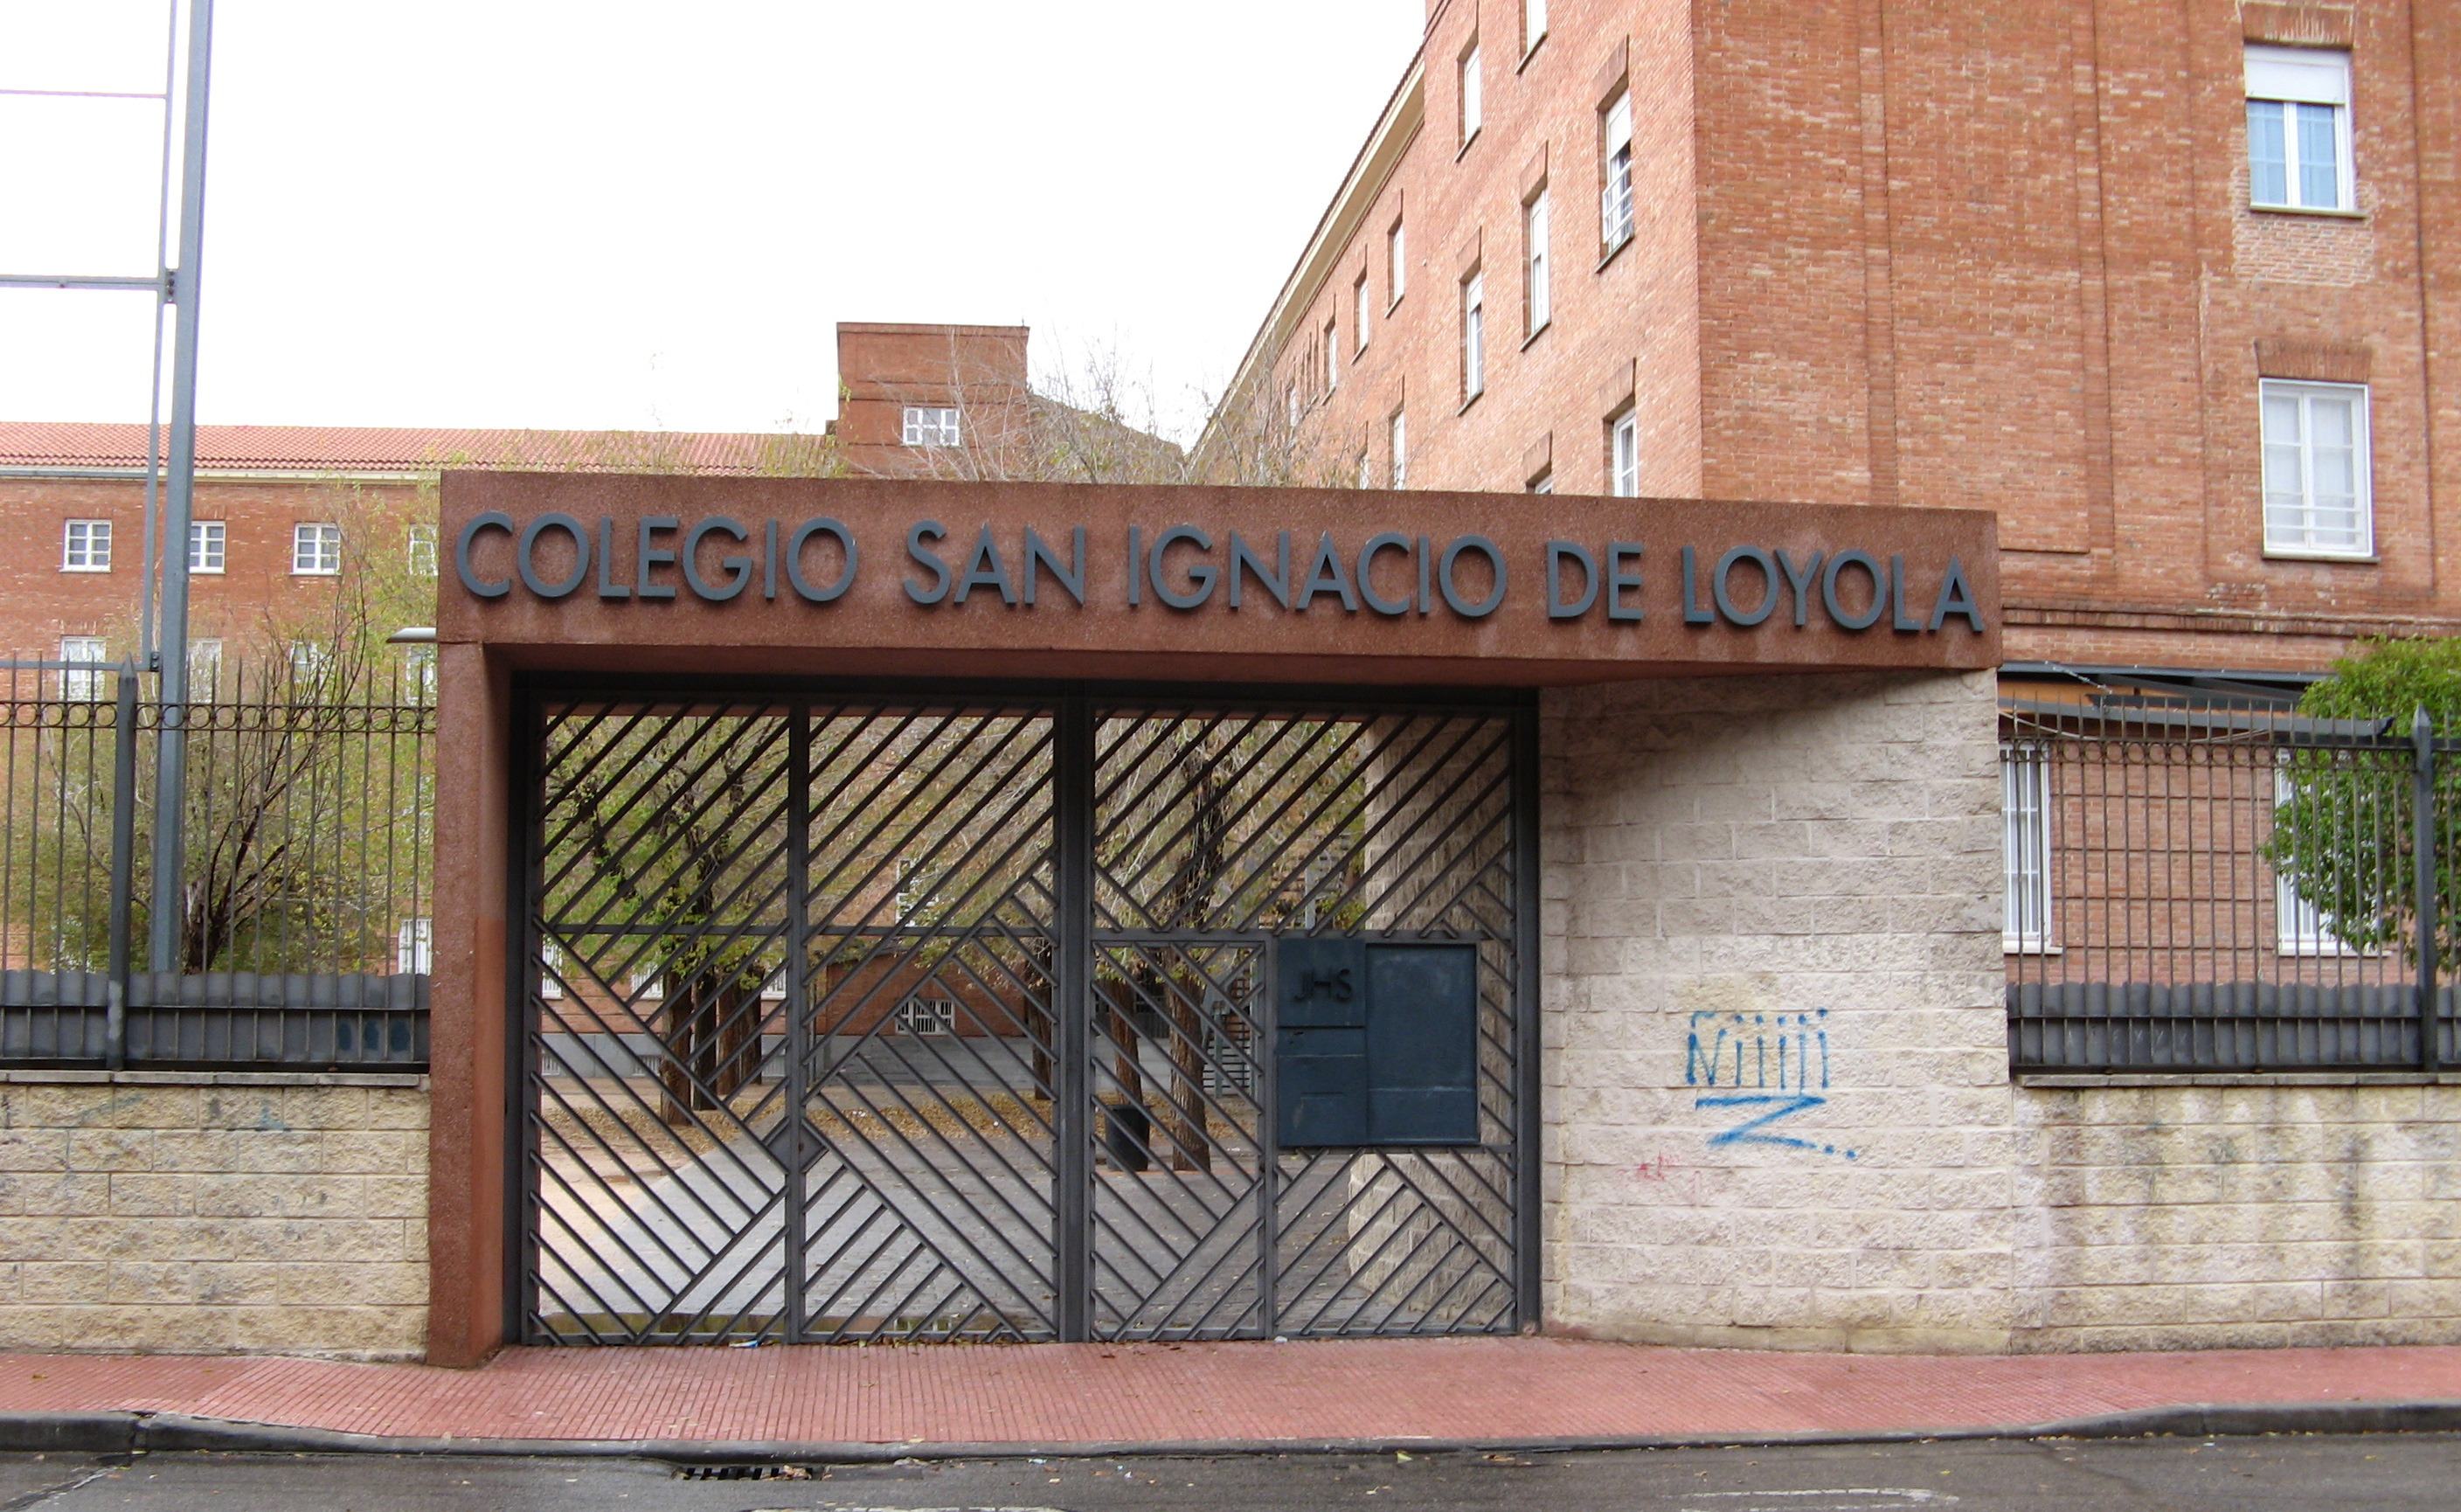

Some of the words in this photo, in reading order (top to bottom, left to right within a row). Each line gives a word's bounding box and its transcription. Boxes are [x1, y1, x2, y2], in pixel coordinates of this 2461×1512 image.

[454, 510, 859, 603] COLEGIO
[902, 518, 1087, 607] SAN
[1127, 524, 1508, 619] IGNACIO
[1546, 538, 1645, 622] DE
[1681, 544, 1986, 633] LOYOLA
